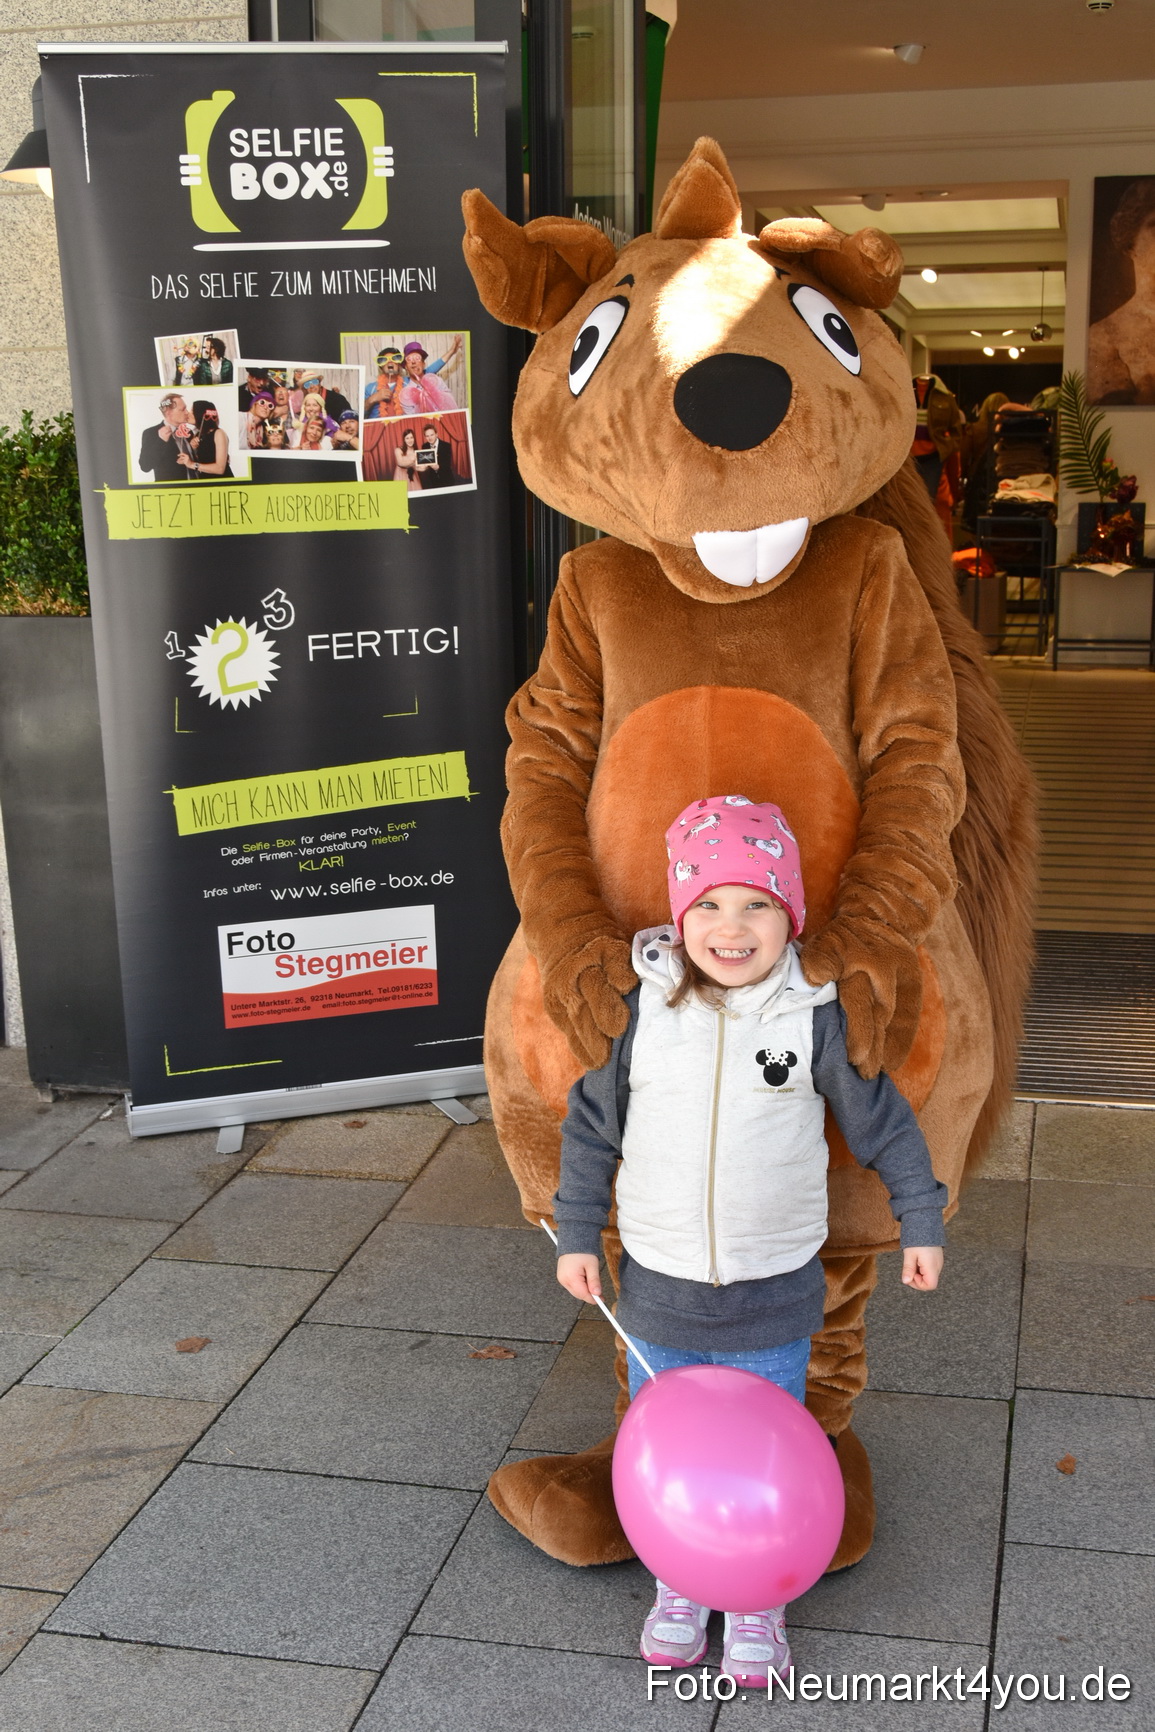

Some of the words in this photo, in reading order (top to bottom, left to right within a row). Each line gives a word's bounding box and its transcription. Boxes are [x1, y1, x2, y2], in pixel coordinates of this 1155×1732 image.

[229, 128, 345, 158] SELFIE
[230, 161, 333, 200] BOX
[151, 274, 189, 299] DAS
[199, 272, 259, 298] SELFIE
[270, 271, 312, 297] ZUM
[321, 266, 436, 295] MITNEHMEN!
[132, 493, 196, 529] JETZT
[210, 491, 252, 526] HIER
[265, 493, 380, 523] AUSPROBIEREN
[164, 630, 186, 660] 1
[211, 622, 259, 696] 2
[261, 588, 295, 630] 3
[308, 626, 459, 662] FERTIG!
[191, 790, 239, 828] MICH
[249, 781, 309, 819] KANN
[318, 773, 364, 809] MAN
[373, 762, 450, 802] MIETEN!
[220, 847, 238, 857] Die
[242, 838, 296, 853] Selfie-Box
[320, 830, 347, 842] deine
[351, 826, 382, 838] Party,
[387, 820, 417, 832] Event
[231, 856, 254, 866] oder
[259, 840, 367, 862] Firmen-Veranstaltung
[371, 833, 410, 846] mieten?
[299, 855, 344, 872] KLAR!
[203, 886, 228, 899] Infos
[233, 882, 262, 894] unter:
[271, 870, 455, 901] www.selfie-box.de
[226, 929, 296, 956] Foto
[275, 943, 428, 979] Stegmeier
[231, 1002, 257, 1011] Untere
[258, 998, 292, 1008] Marktstr.
[310, 993, 333, 1003] 92318
[335, 989, 374, 1000] Neumarkt,
[231, 1004, 311, 1019] www.foto-stegmeier.de
